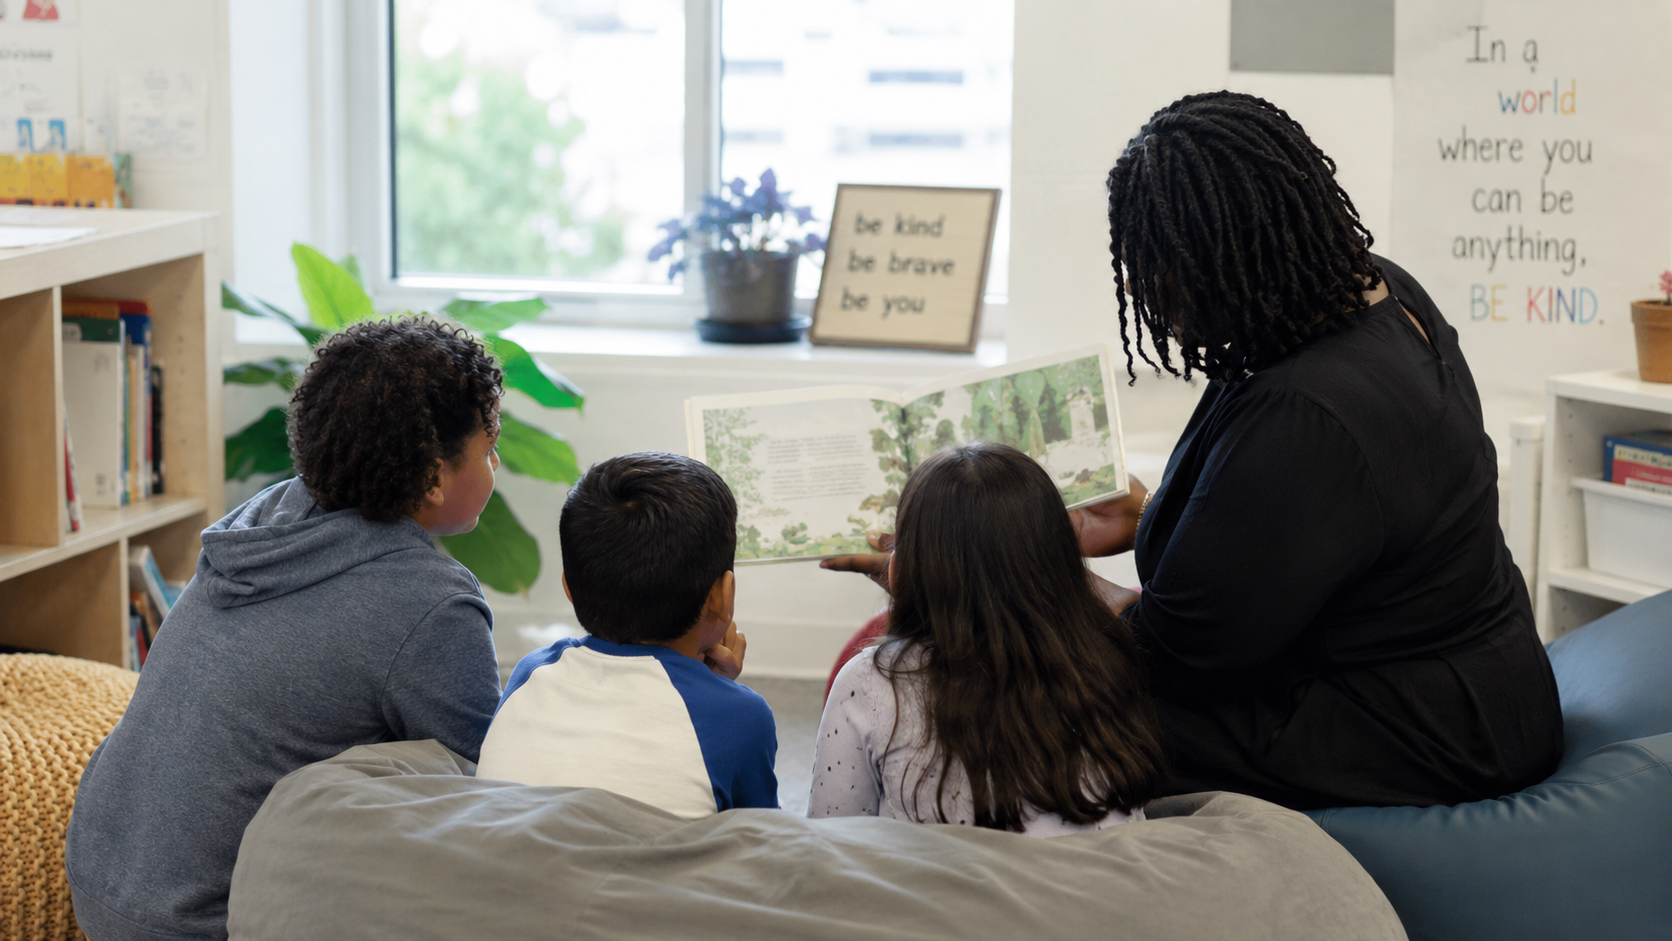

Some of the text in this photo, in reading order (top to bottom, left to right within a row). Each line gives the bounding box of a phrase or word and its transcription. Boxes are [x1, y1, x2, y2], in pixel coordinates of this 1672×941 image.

[1466, 25, 1506, 63] In
[1498, 78, 1577, 115] world
[1438, 126, 1592, 175] where you
[1472, 177, 1574, 215] can be
[854, 211, 945, 238] be kind
[847, 248, 955, 276] be brave
[1452, 225, 1586, 277] anything,
[840, 286, 926, 319] be you
[1470, 284, 1604, 325] BE KIND.
